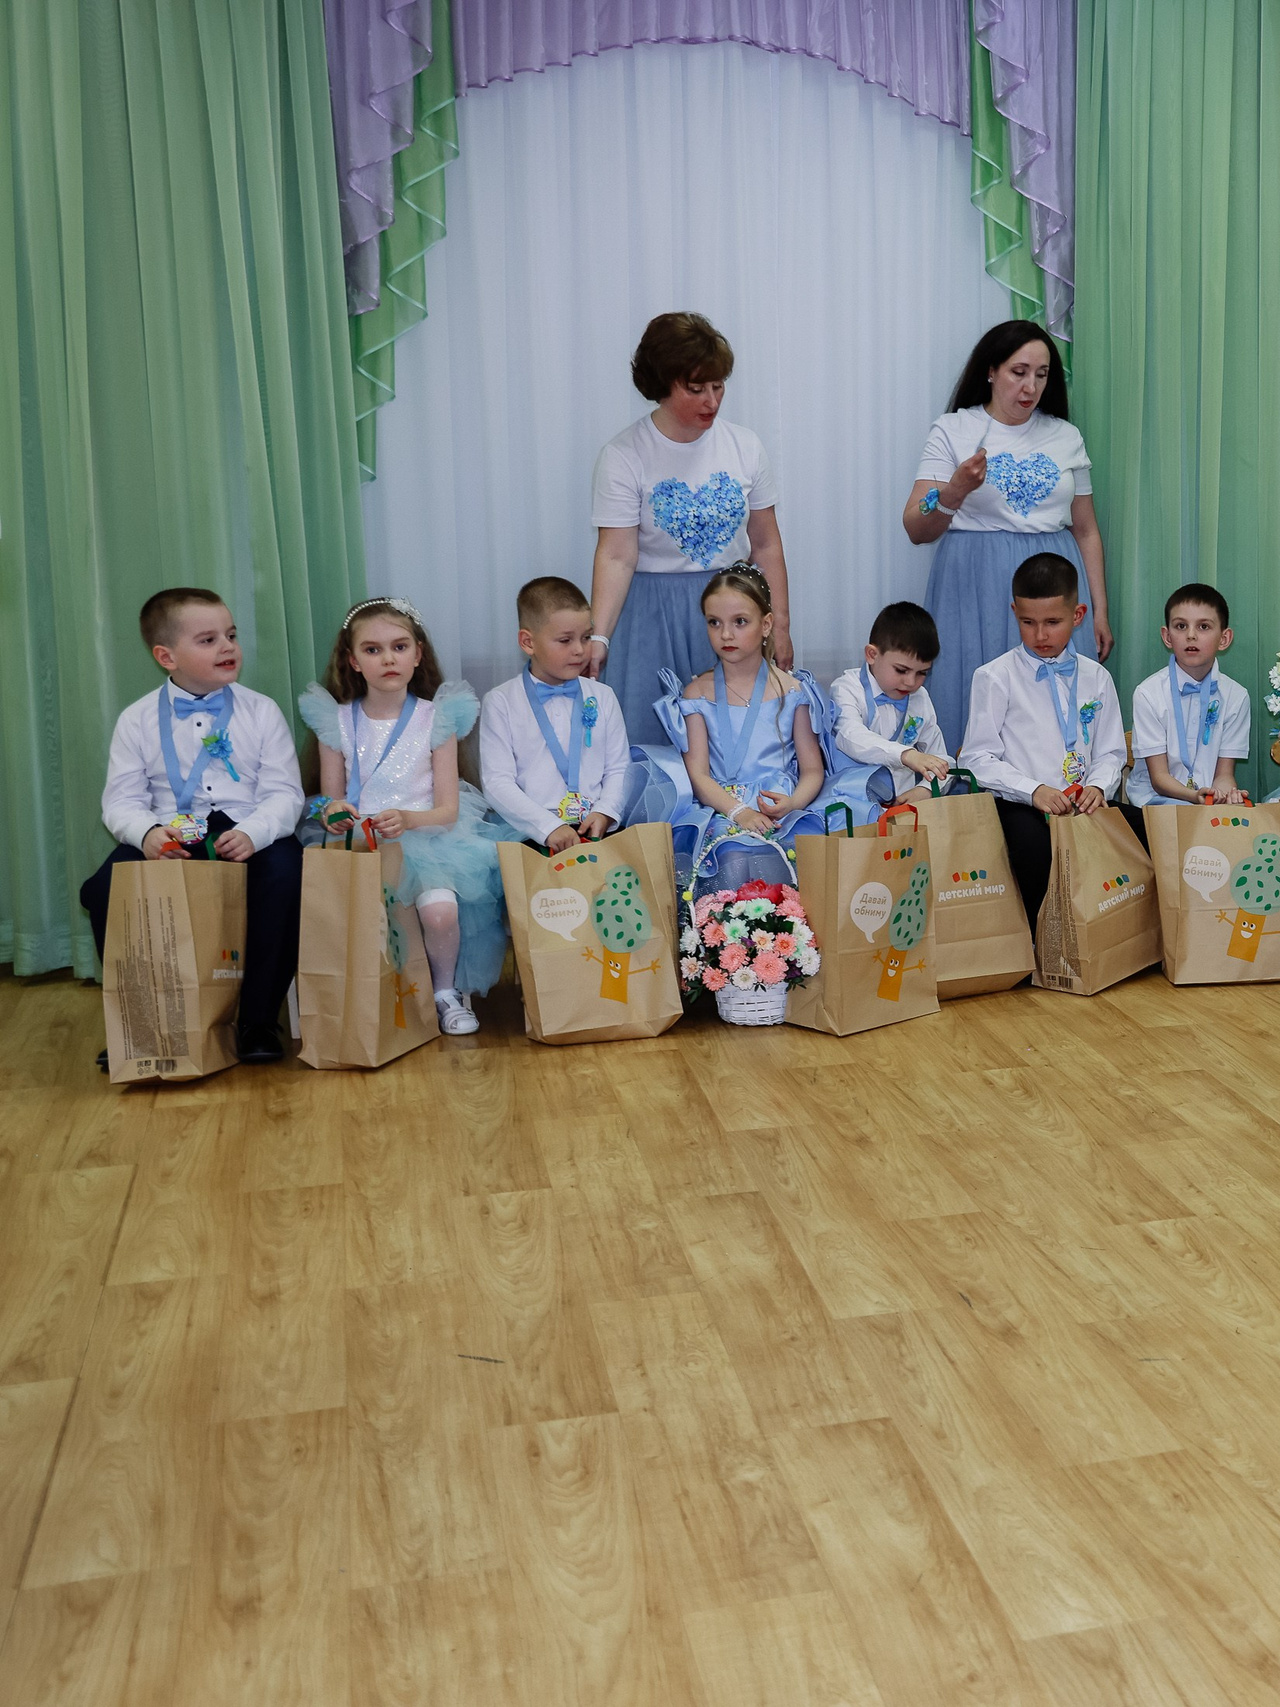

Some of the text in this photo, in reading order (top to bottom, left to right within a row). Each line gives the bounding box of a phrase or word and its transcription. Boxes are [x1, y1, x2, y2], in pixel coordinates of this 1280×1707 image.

[1189, 855, 1221, 867] Давай
[1184, 867, 1224, 881] обниму
[860, 893, 887, 905] Давай
[938, 883, 1005, 902] детский мир
[1097, 883, 1146, 913] детский мир
[539, 896, 577, 909] Давай
[536, 909, 582, 919] обниму
[854, 906, 887, 919] обниму
